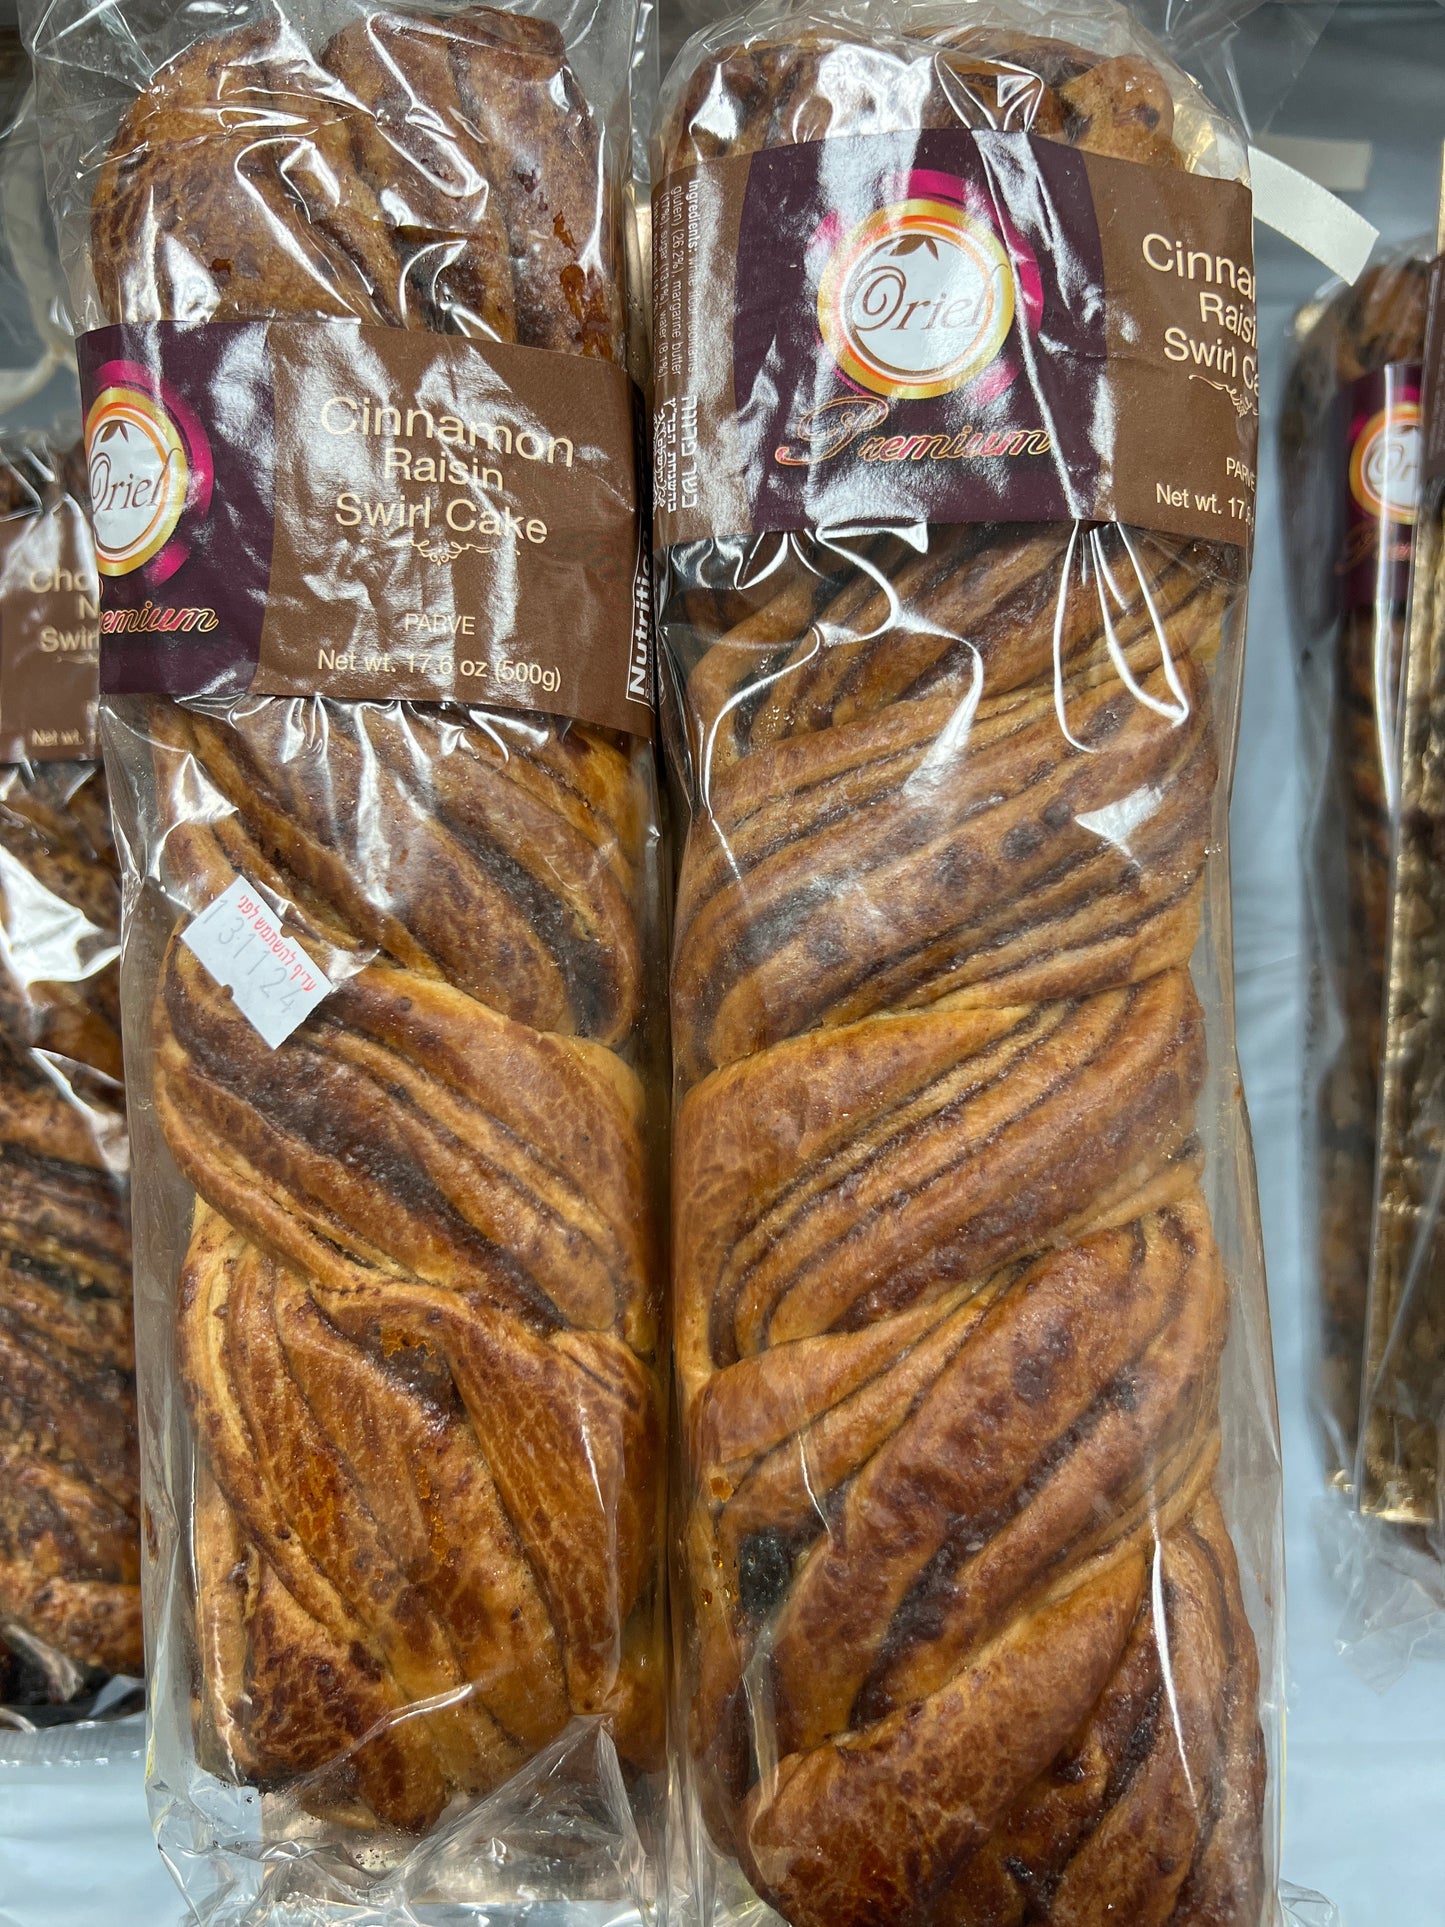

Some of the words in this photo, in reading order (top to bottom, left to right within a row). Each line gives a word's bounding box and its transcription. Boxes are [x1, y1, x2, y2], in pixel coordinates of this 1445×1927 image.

[685, 180, 700, 253] Ingredients:
[1142, 232, 1256, 304] Cinna
[669, 280, 682, 338] margarine
[852, 263, 1009, 332] Oriel
[1200, 291, 1256, 348] Raisi
[671, 341, 684, 375] butter
[1164, 327, 1236, 378] Swirl
[320, 396, 575, 468] Cinnamon
[775, 395, 1052, 466] Premium
[89, 448, 182, 514] Oriel
[383, 447, 503, 491] Raisin
[681, 460, 698, 508] כשר
[335, 492, 431, 530] Swirl
[445, 498, 548, 544] Cake
[1156, 482, 1189, 509] Net
[1195, 493, 1223, 515] wt.
[29, 566, 90, 593] Cho
[100, 600, 219, 632] emium
[404, 612, 476, 636] PARVE
[317, 649, 356, 672] Net
[364, 651, 397, 673] wt.
[407, 653, 453, 675] 17.6
[460, 660, 488, 678] oz
[494, 659, 561, 693] (500g)
[32, 727, 57, 746] Net
[236, 894, 261, 921] לפני
[253, 916, 297, 967] להשתמש
[288, 963, 317, 993] עדיף
